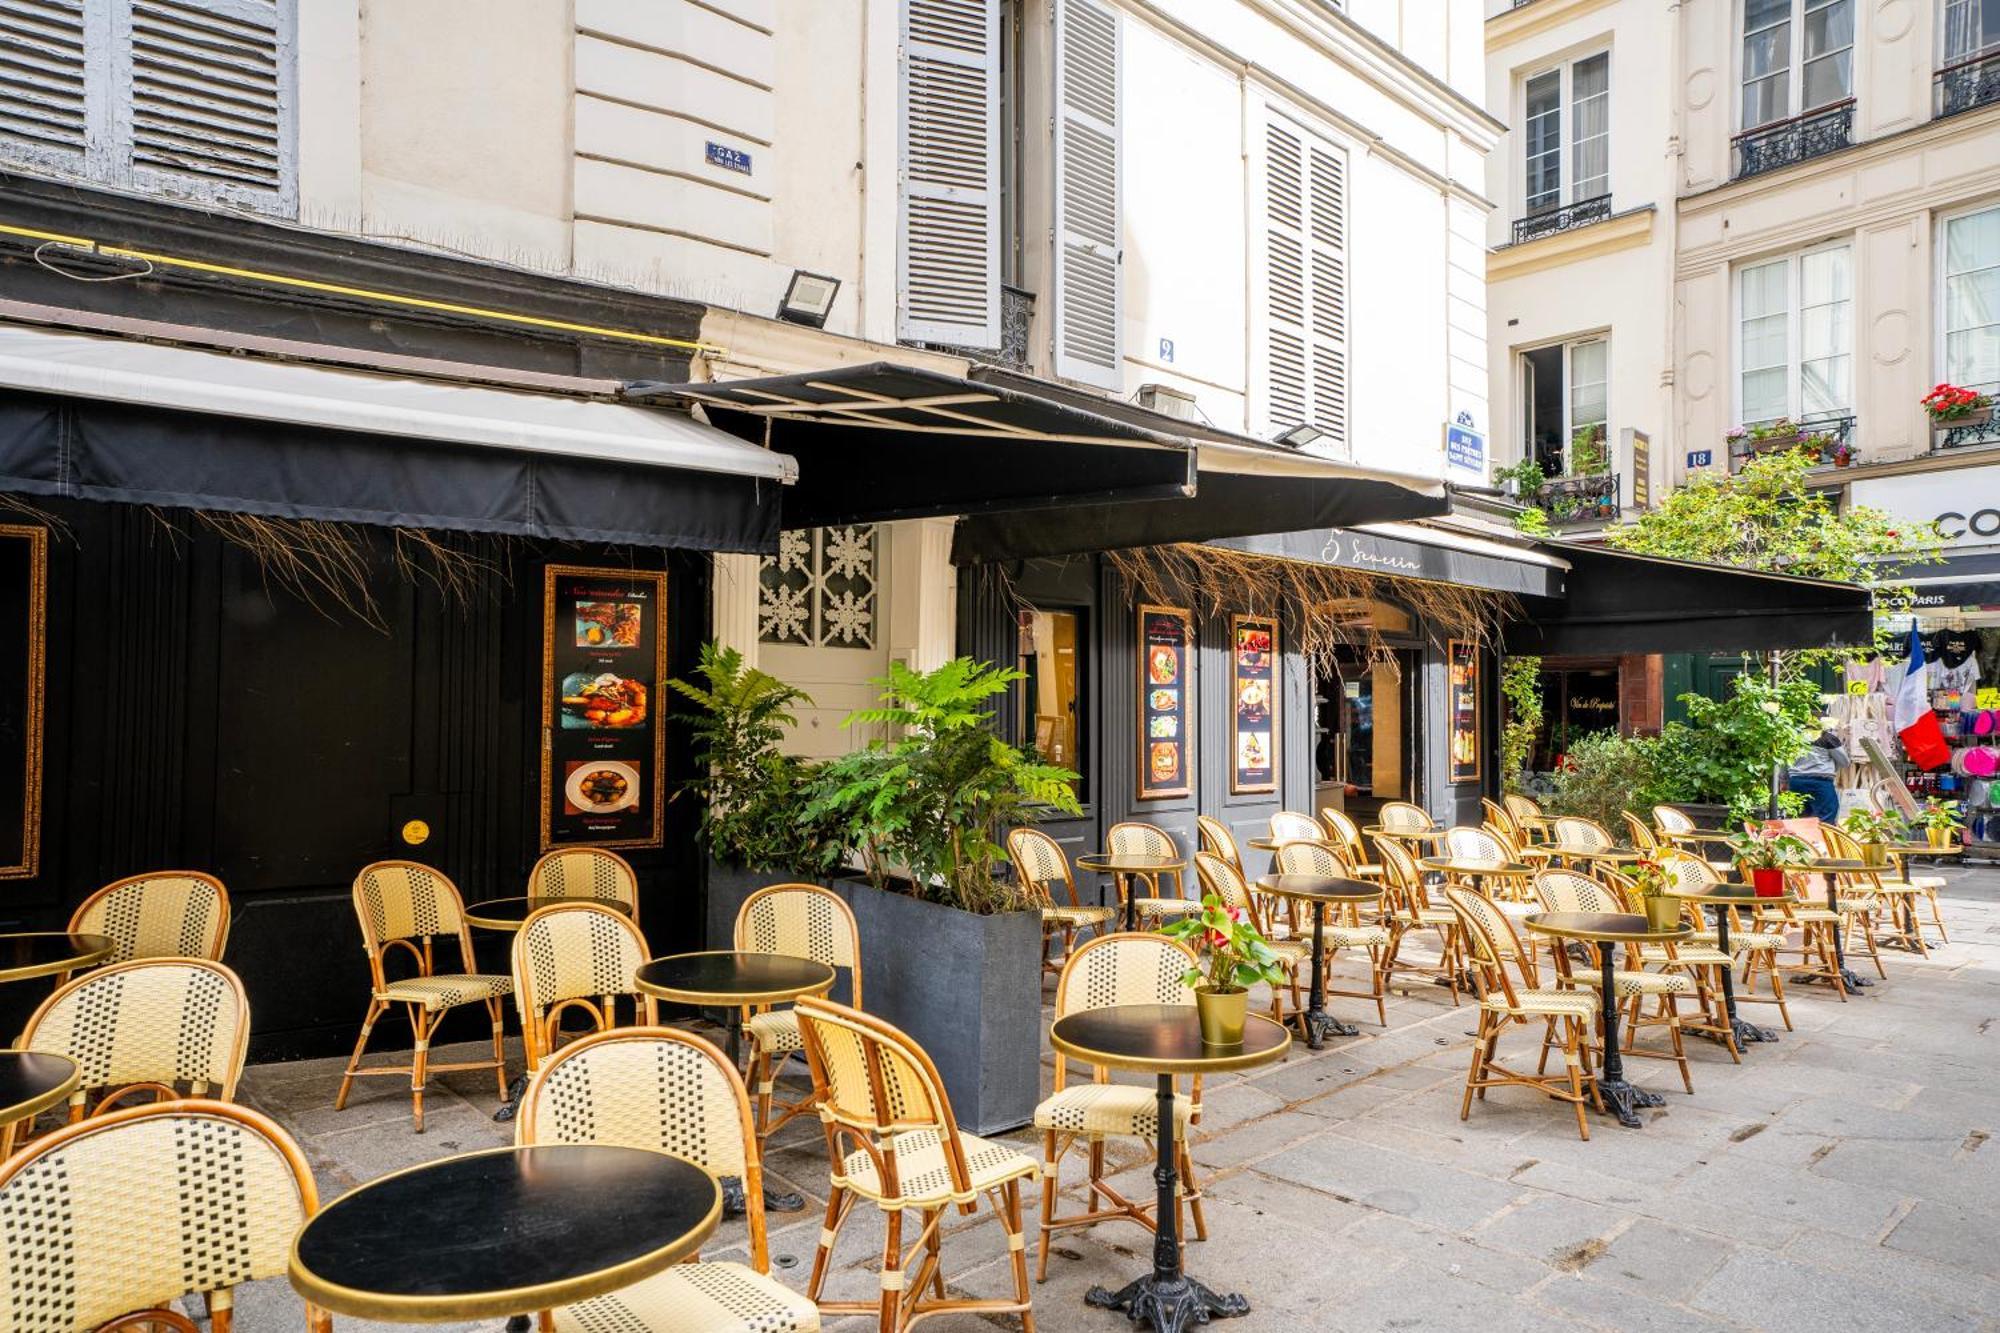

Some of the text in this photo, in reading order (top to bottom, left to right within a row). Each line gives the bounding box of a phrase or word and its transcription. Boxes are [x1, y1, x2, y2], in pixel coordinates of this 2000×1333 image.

[1692, 453, 1706, 466] 18
[1932, 509, 2000, 539] CO
[1911, 595, 1946, 606] PARIS
